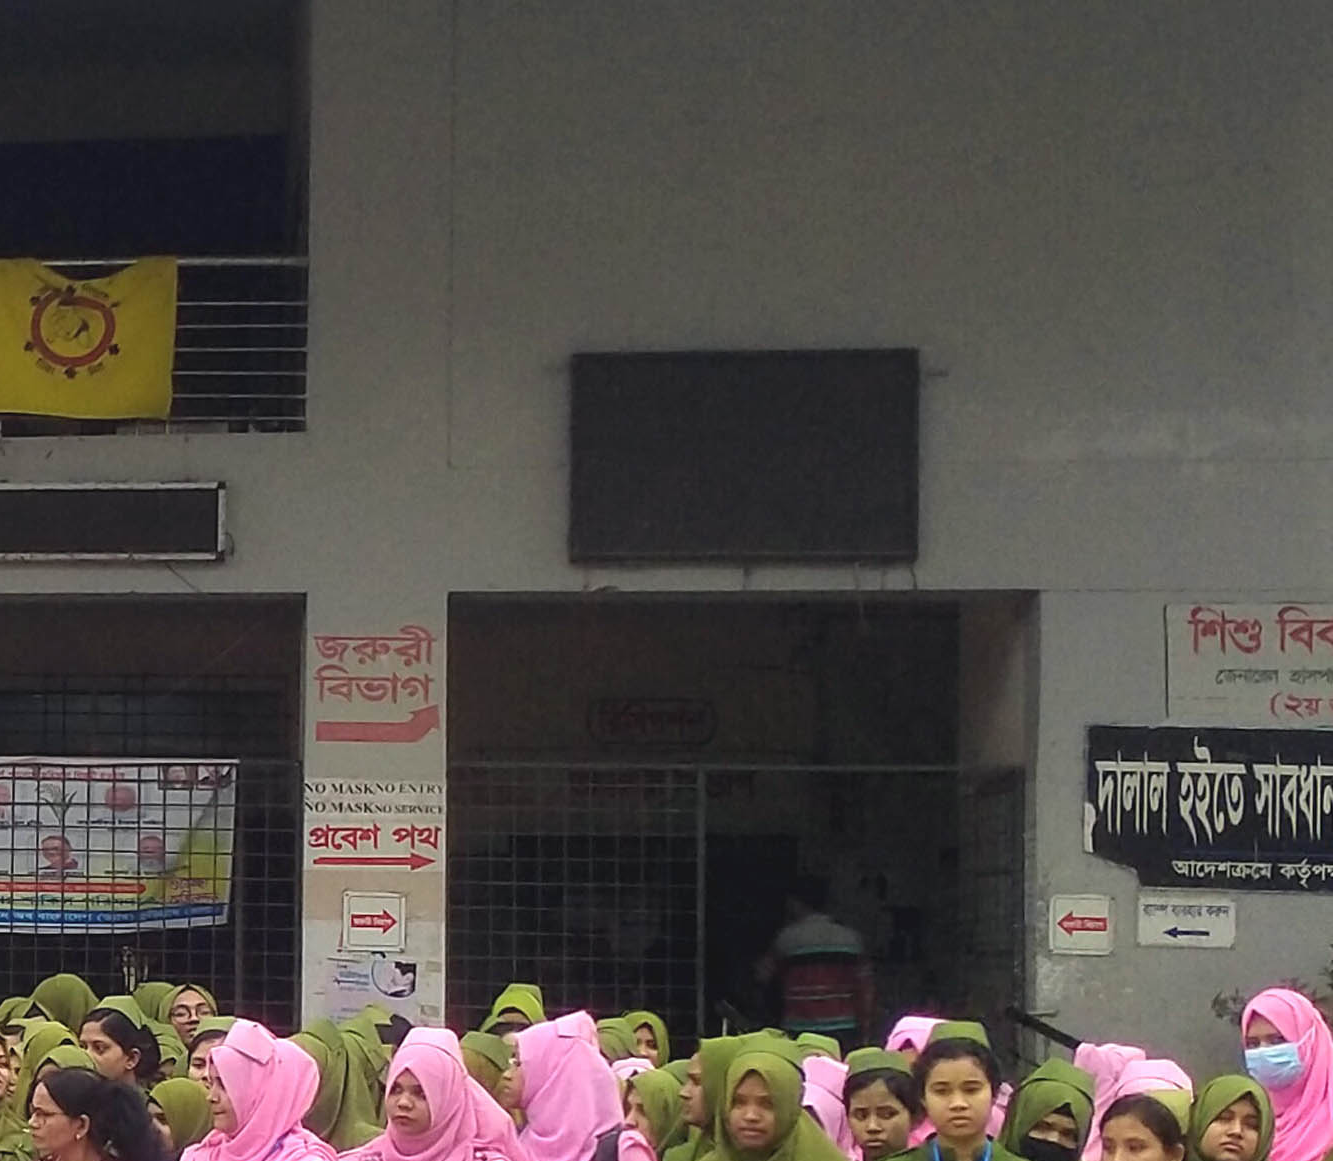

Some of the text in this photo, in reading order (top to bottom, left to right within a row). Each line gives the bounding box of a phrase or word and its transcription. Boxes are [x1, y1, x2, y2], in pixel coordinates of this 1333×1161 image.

[313, 625, 437, 668] জরুরী
[1187, 606, 1263, 655] শিশু
[314, 664, 435, 704] বিভাগ
[305, 783, 443, 795] NO MASK NO ENTRY
[1094, 750, 1171, 837] দালাল
[1175, 735, 1247, 848] হইতে
[305, 801, 443, 814] NO MASK NO SERVICE
[308, 823, 442, 850] প্রবেশ পথ
[1171, 859, 1273, 880] আদেশক্রমে
